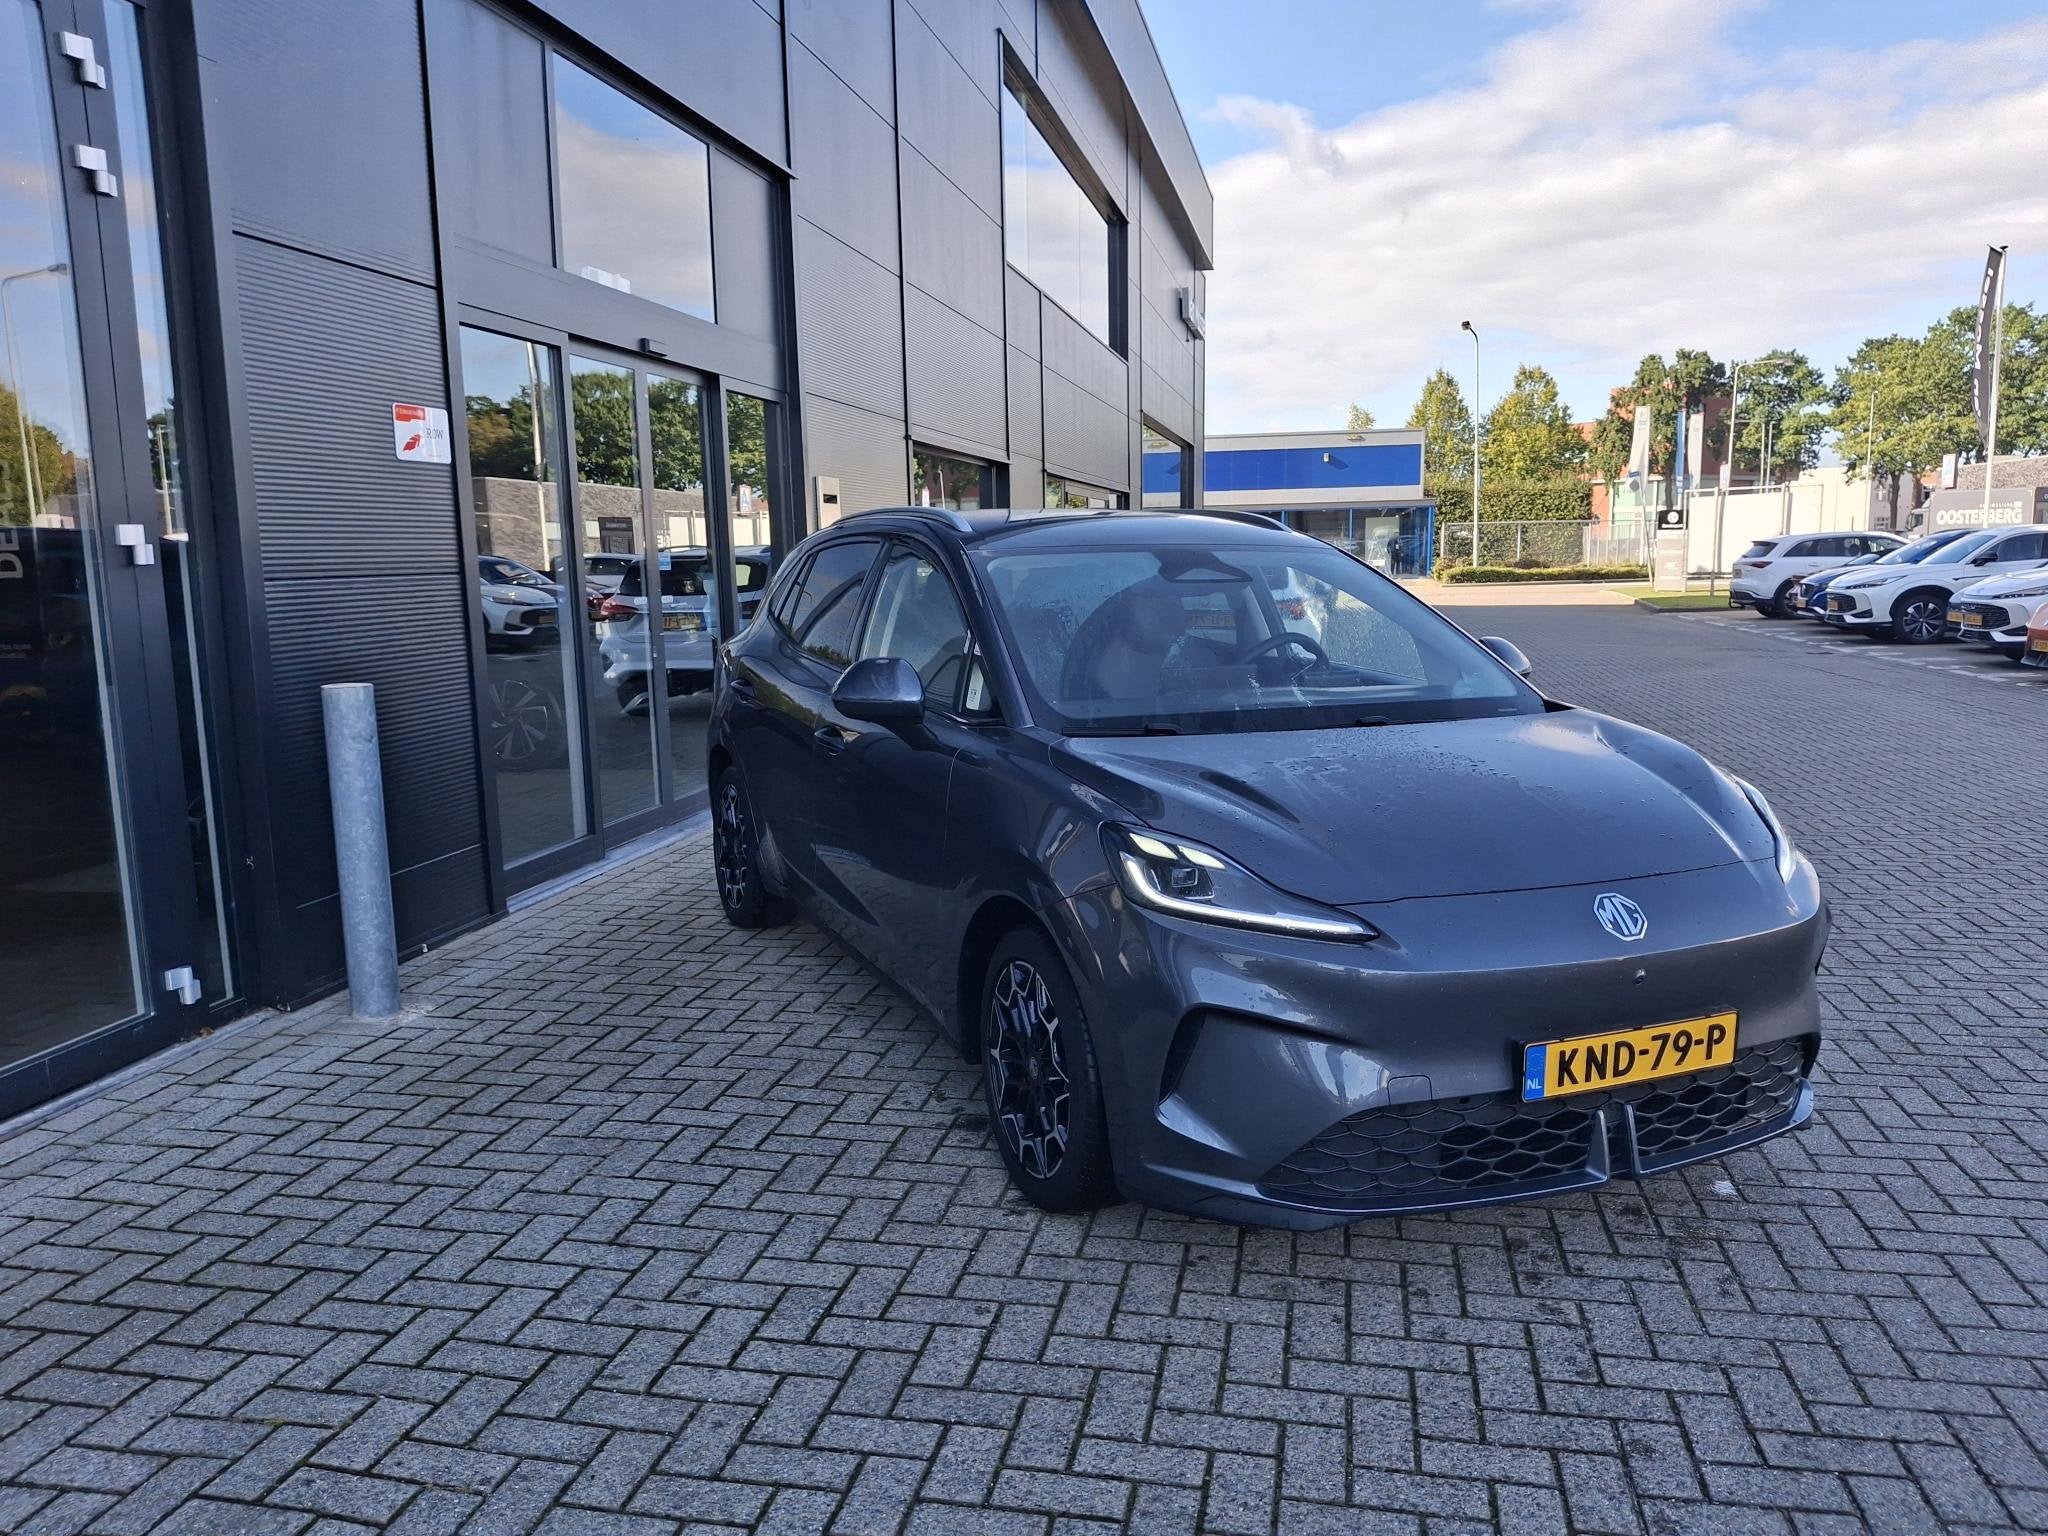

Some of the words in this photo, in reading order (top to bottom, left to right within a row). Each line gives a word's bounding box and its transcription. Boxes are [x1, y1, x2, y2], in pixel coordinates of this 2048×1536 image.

[1597, 896, 1646, 938] MG
[1557, 1023, 1727, 1088] KND-79-P
[1526, 1078, 1543, 1090] NL
